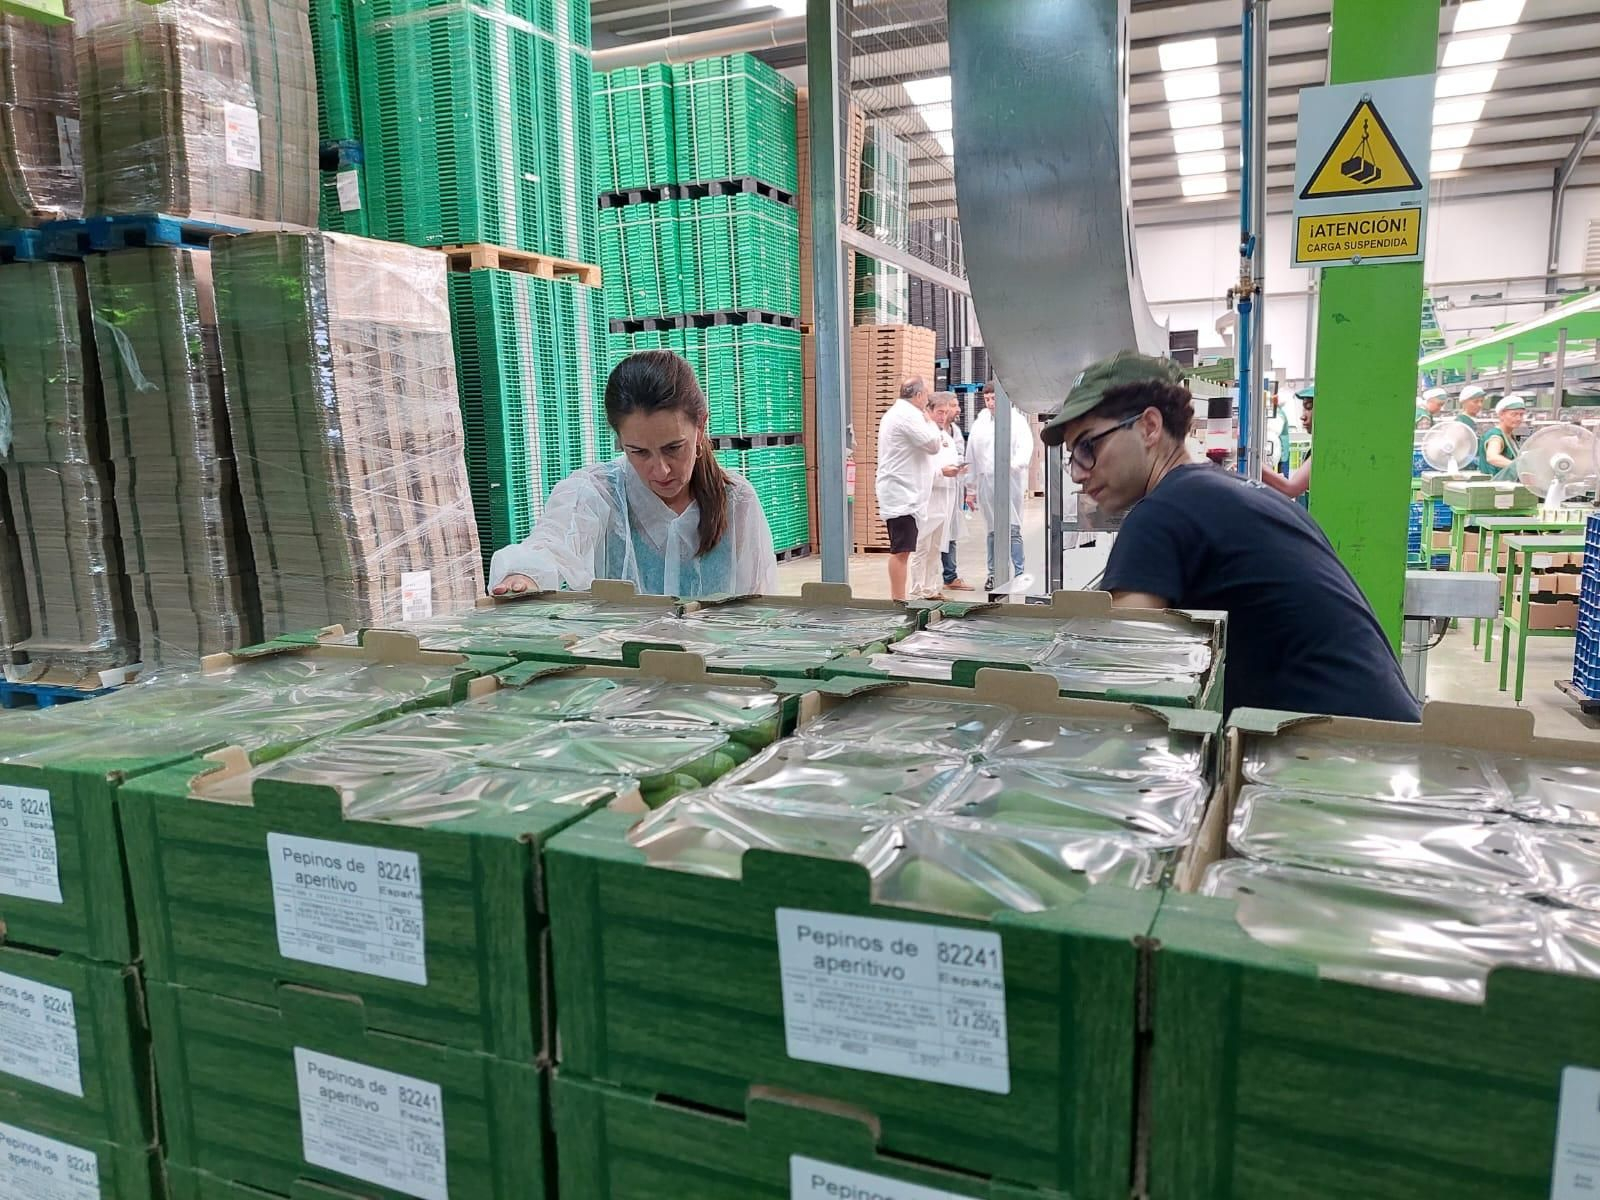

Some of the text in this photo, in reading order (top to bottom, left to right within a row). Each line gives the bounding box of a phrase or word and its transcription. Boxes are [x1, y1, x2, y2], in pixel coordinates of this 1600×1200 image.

[1310, 216, 1407, 238] ¡ATENCIÓN!
[1307, 238, 1408, 253] CARGA SUSPENDIDA
[21, 798, 50, 817] 82241
[282, 847, 366, 874] Pepinos de
[377, 860, 418, 883] 82241
[295, 871, 358, 893] aperitivo
[379, 886, 422, 899] España
[385, 916, 394, 931] 12
[402, 918, 421, 940] 250g
[797, 925, 919, 958] Pepinos de
[937, 942, 999, 970] 82241
[813, 954, 906, 982] aperitivo
[938, 972, 1003, 990] España
[947, 1008, 960, 1027] 12
[972, 1009, 1001, 1038] 250g
[307, 1062, 388, 1096] Pepinos de
[319, 1086, 380, 1112] aperitivo
[398, 1085, 438, 1112] 82241
[8, 1152, 54, 1175] aperitivo
[44, 1149, 59, 1162] de
